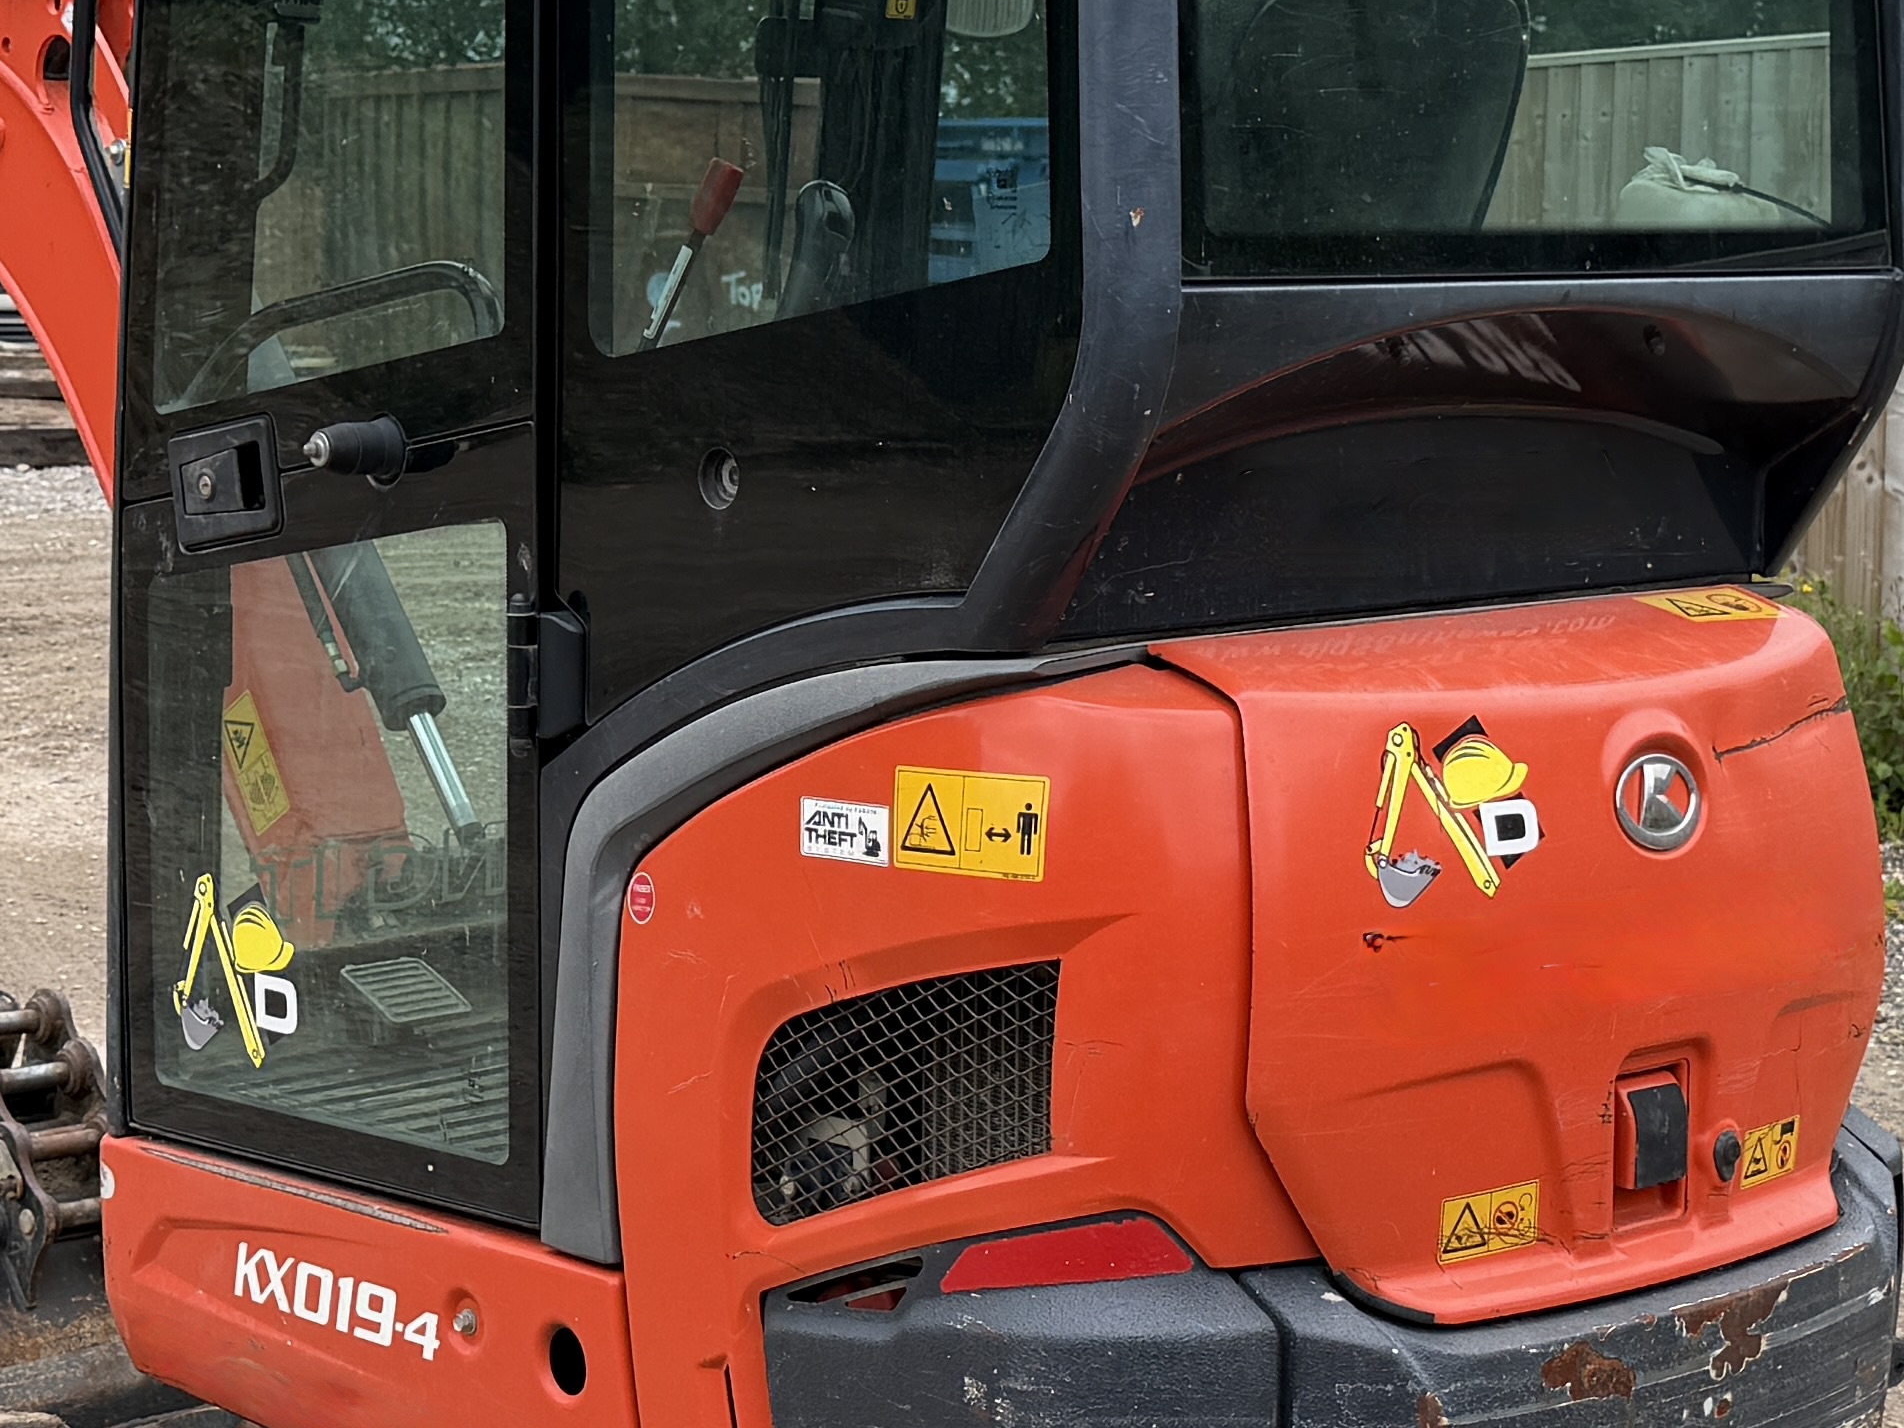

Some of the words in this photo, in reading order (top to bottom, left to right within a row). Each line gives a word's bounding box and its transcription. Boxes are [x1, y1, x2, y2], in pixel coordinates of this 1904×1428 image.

[804, 810, 849, 830] ANTI
[804, 826, 858, 849] THEFT
[234, 1241, 440, 1361] KX019-4
